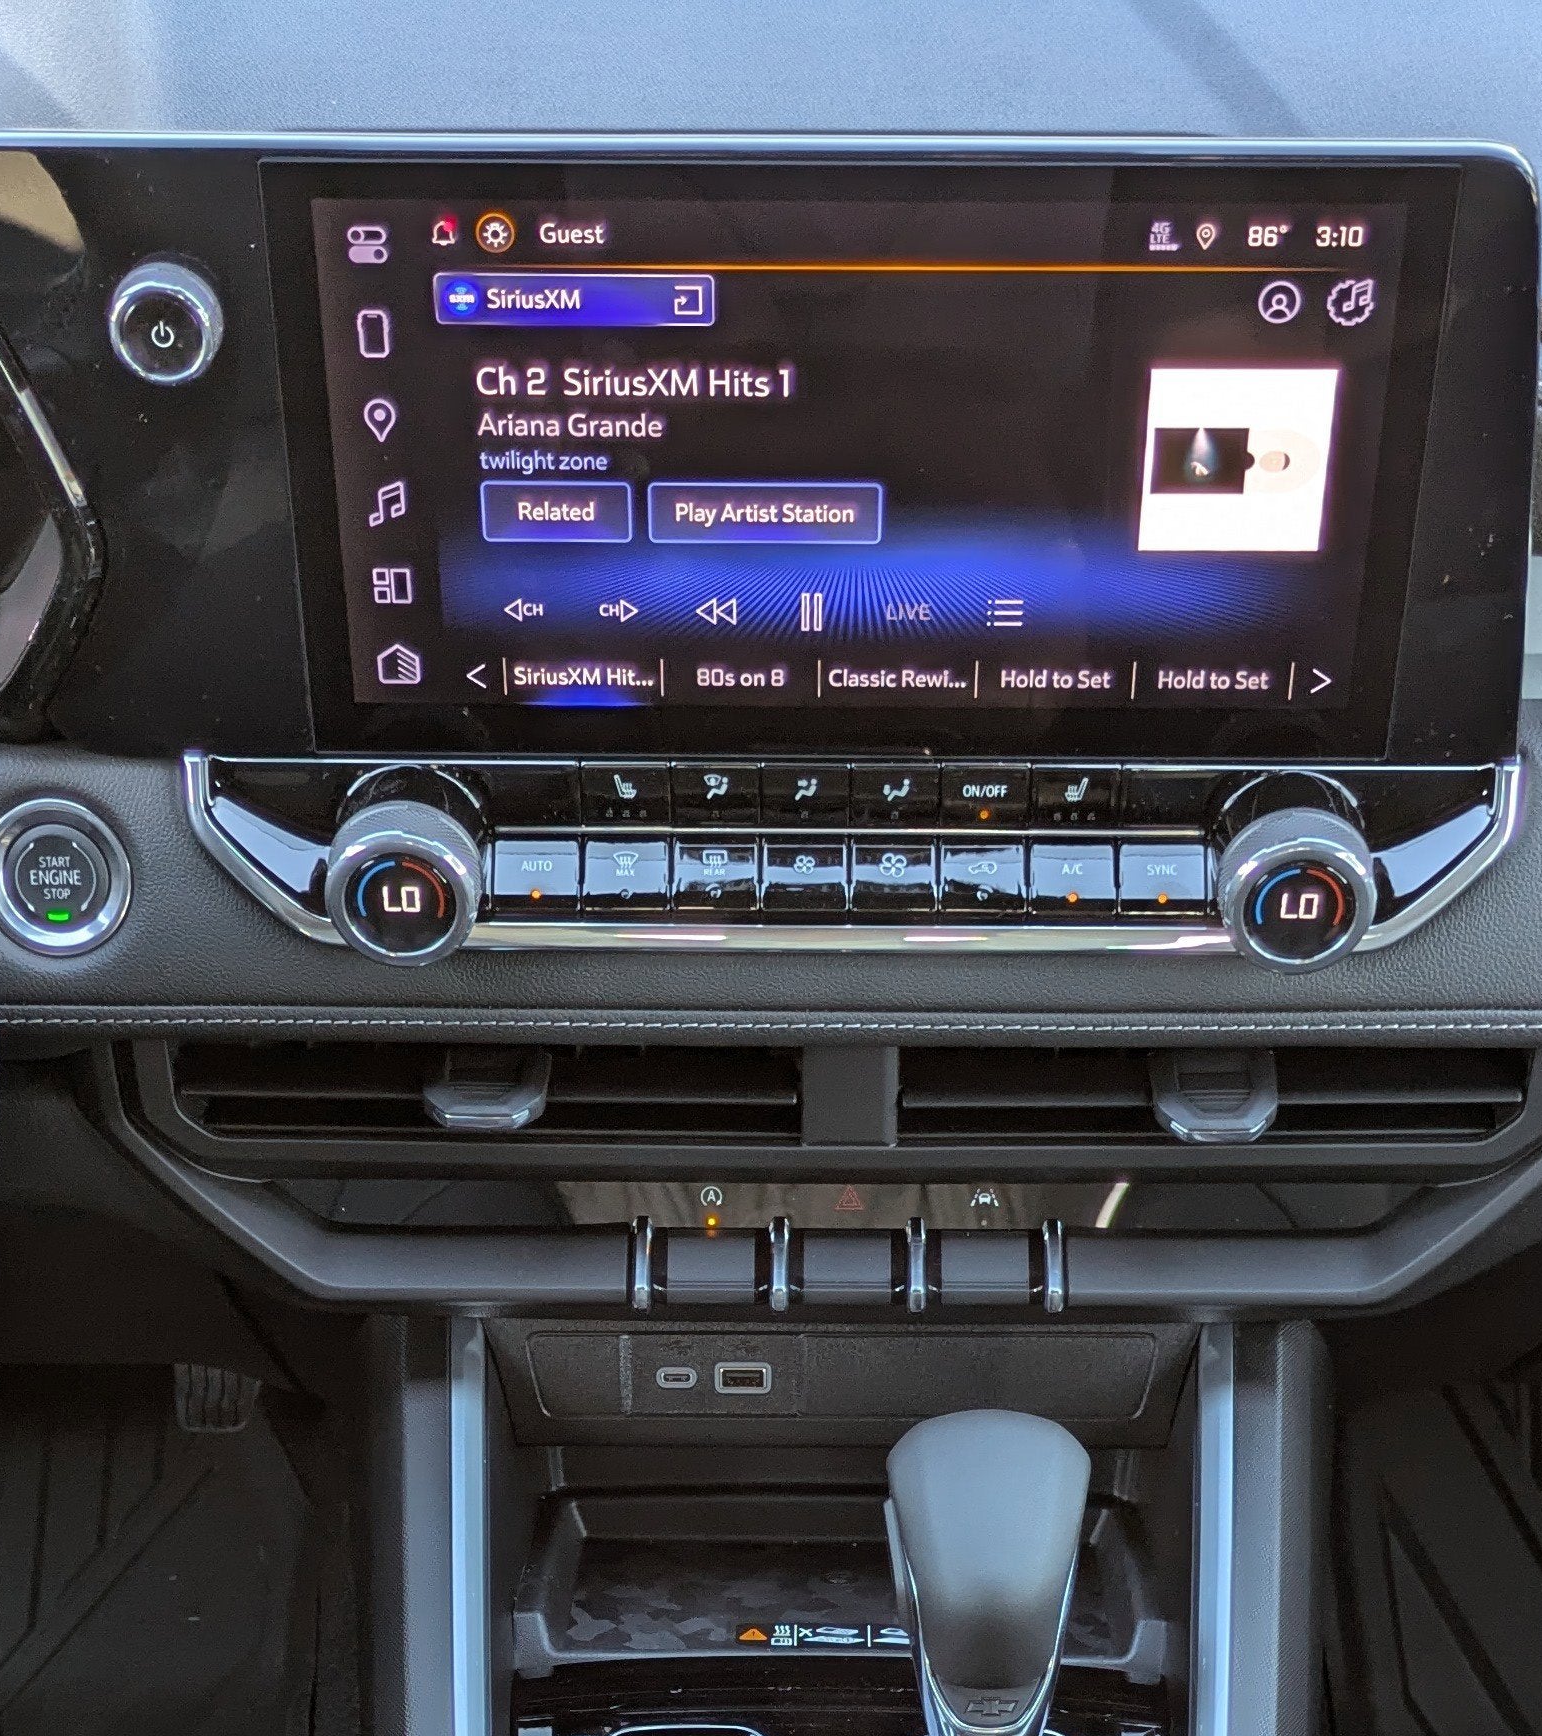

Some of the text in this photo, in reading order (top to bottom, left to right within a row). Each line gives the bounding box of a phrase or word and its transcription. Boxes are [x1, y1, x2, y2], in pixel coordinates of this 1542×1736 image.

[539, 223, 605, 246] Guest
[1316, 226, 1364, 247] 3:10
[486, 287, 581, 310] SiriusXM
[475, 365, 792, 398] Ch 2 SiriusXM Hits 1
[477, 413, 663, 439] Ariana Grande
[479, 450, 608, 475] twilight zone
[517, 501, 595, 522] Related
[674, 503, 855, 527] Play Artist Station
[523, 602, 544, 618] CH
[599, 602, 620, 618] CH
[885, 602, 933, 621] LIVE
[513, 666, 602, 688] SiriusXM
[696, 667, 785, 688] 80s on 8
[828, 667, 896, 689] Classic
[1000, 669, 1111, 690] Hold to Set
[1157, 669, 1269, 691] Hold to Set
[962, 784, 1008, 799] ON/OFF
[38, 856, 71, 869] START
[521, 859, 553, 873] AUTO
[615, 867, 636, 878] MAX
[702, 867, 726, 878] REAR
[1061, 862, 1084, 877] A/C
[1146, 862, 1178, 877] SYNC
[29, 869, 82, 887] ENGINE
[43, 888, 72, 901] STOP
[382, 885, 421, 914] LO
[1280, 893, 1319, 920] LO
